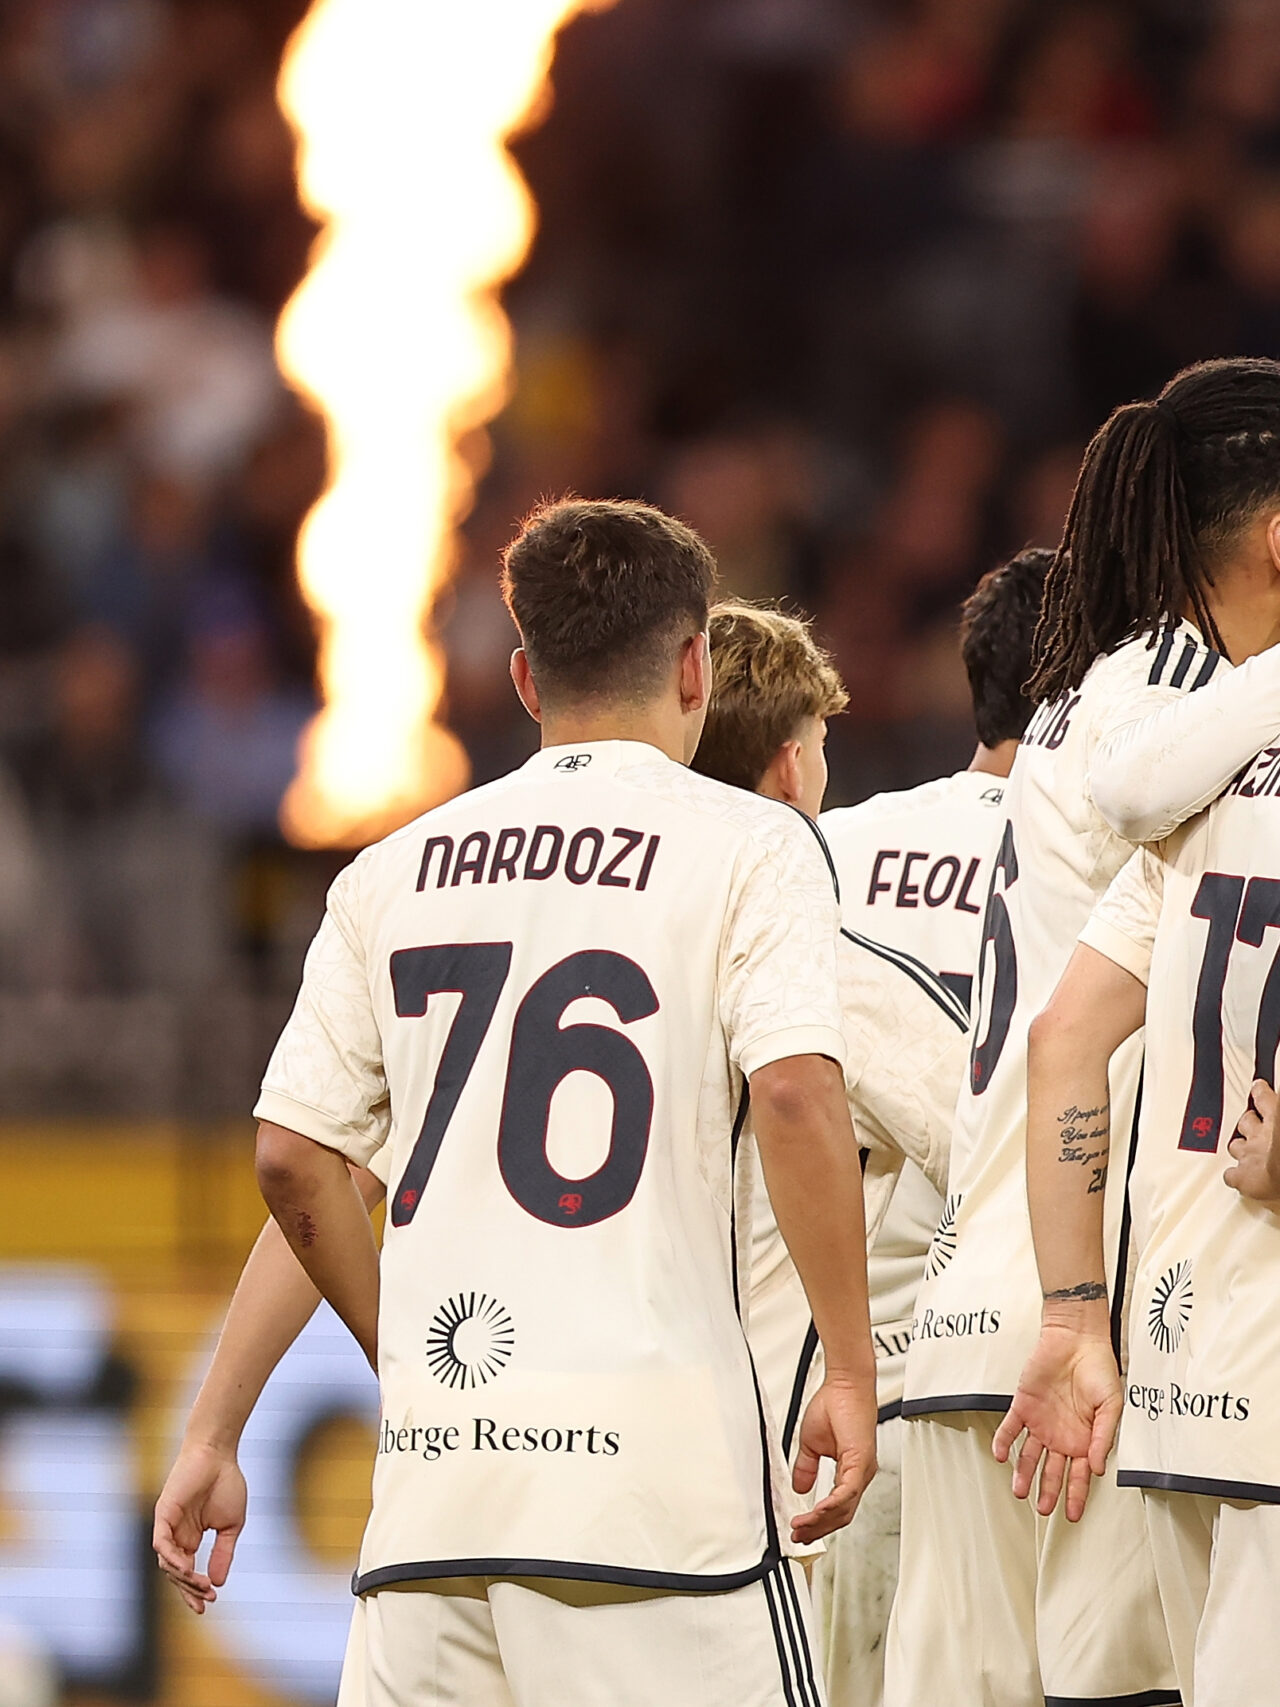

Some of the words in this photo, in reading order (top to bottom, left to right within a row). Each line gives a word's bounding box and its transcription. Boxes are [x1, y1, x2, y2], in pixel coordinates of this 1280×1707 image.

[416, 825, 661, 892] NARDOZI
[866, 850, 981, 914] FEOL
[390, 941, 660, 1228] 76
[920, 1306, 1001, 1340] Resorts
[1170, 1382, 1250, 1421] Rsorts
[379, 1419, 460, 1461] berge
[472, 1417, 620, 1456] Resorts
